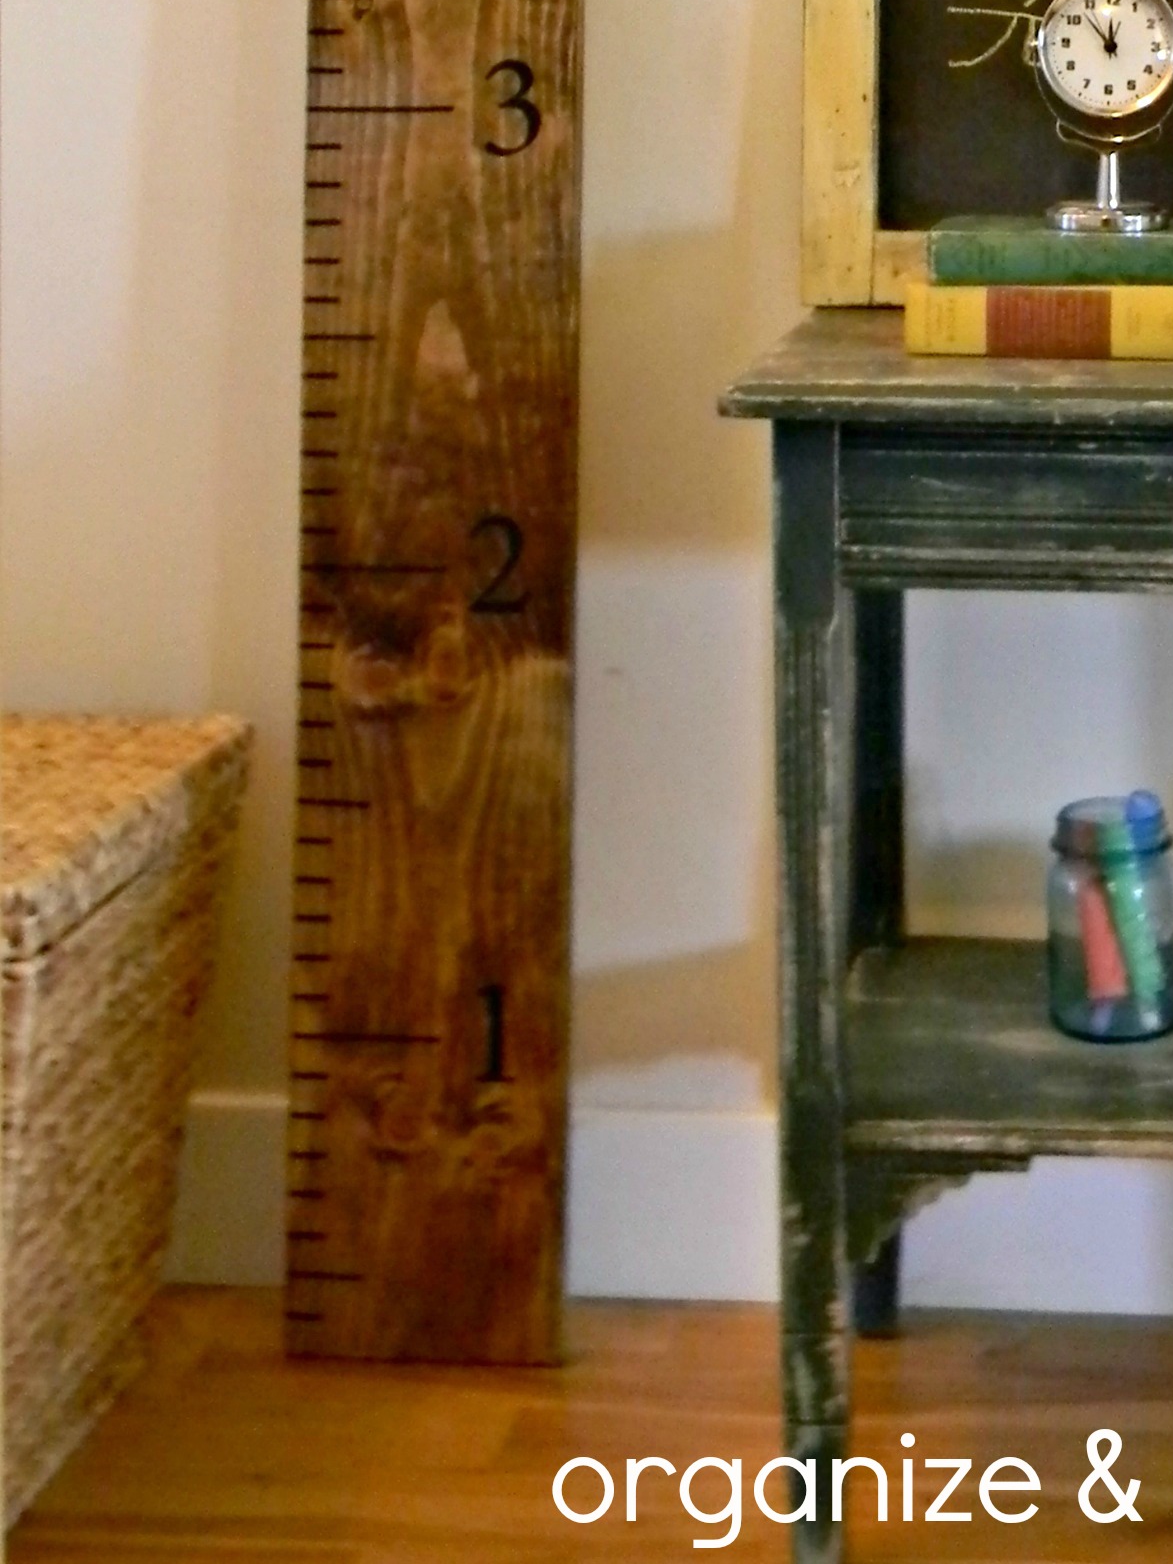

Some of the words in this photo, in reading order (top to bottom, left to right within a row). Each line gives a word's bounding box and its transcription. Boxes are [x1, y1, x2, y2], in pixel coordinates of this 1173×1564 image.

[1131, 1, 1138, 13] 1
[1066, 14, 1082, 26] 10
[1146, 18, 1156, 30] 2
[1061, 37, 1071, 49] 9
[1066, 60, 1076, 72] 8
[1143, 64, 1154, 76] 4
[1083, 78, 1092, 89] 7
[1126, 79, 1137, 91] 5
[1103, 84, 1114, 96] 6
[483, 58, 543, 157] 3
[469, 515, 530, 614] 2
[476, 983, 514, 1084] 1
